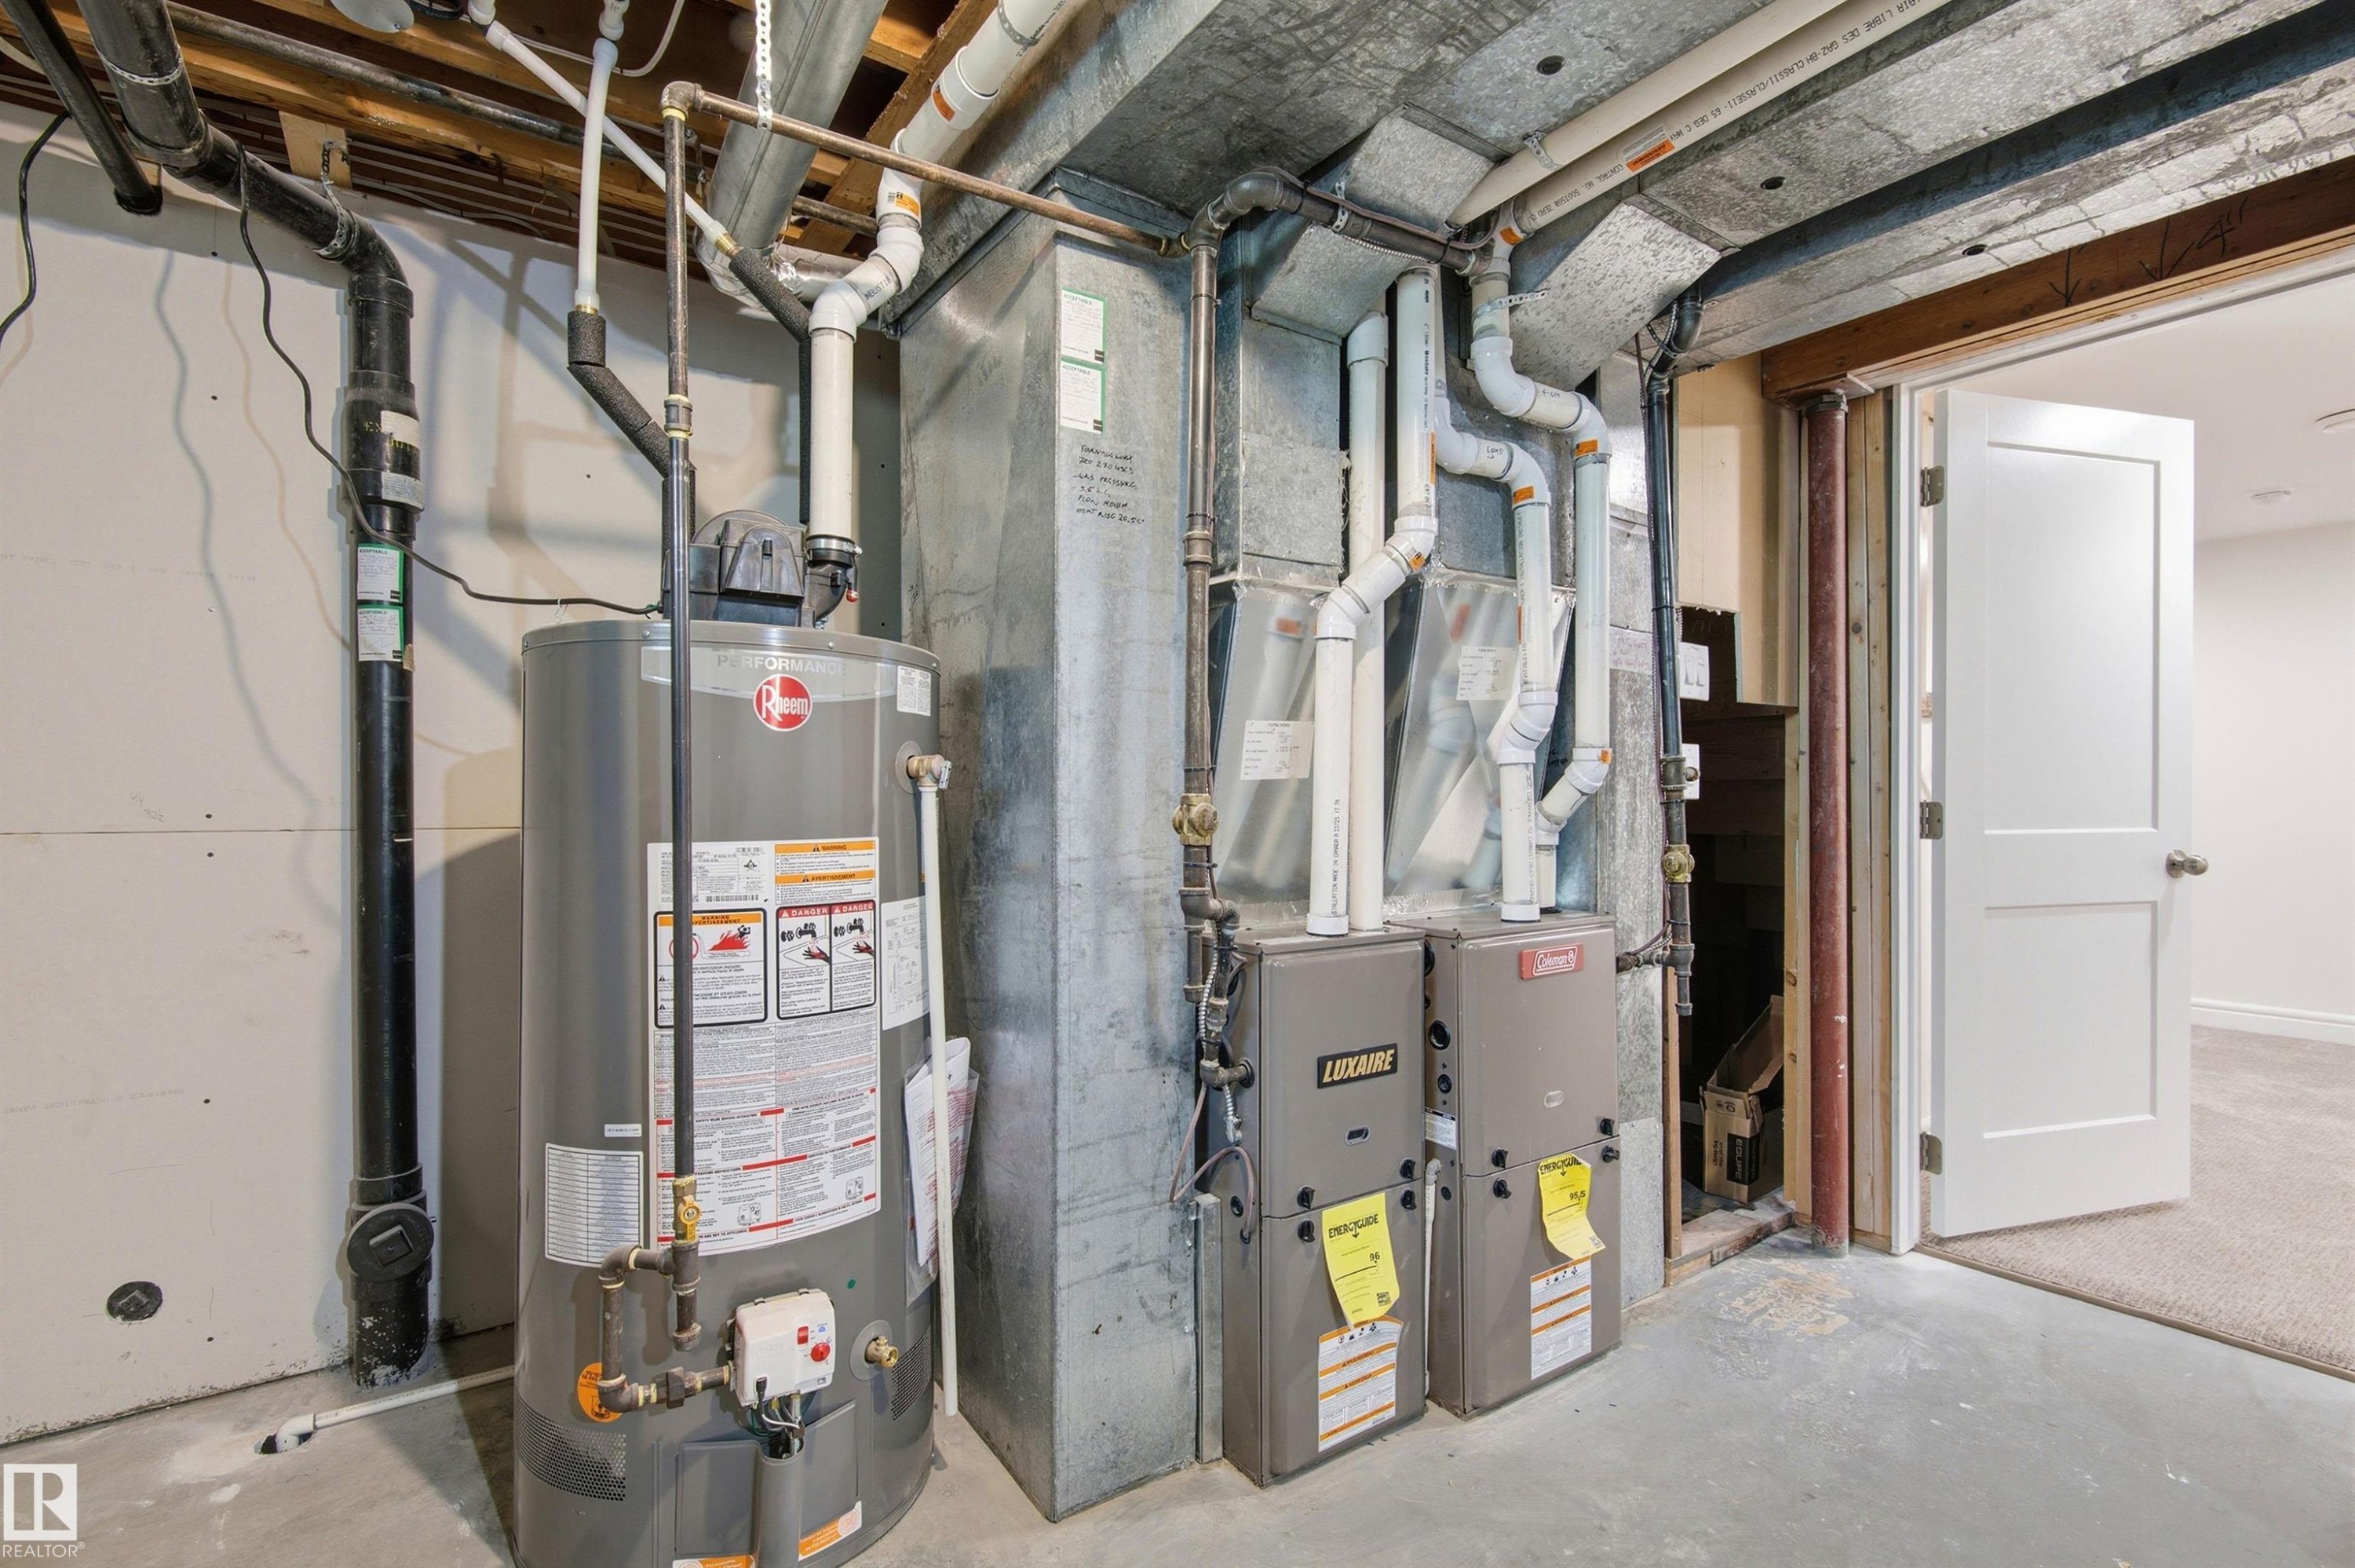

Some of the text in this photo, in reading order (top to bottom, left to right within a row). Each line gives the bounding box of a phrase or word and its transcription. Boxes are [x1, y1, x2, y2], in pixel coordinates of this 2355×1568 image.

[1863, 9, 1893, 32] LIBRE
[1842, 28, 1860, 44] DES
[1806, 40, 1839, 64] GAZ-BH
[1711, 108, 1722, 119] 65
[1685, 124, 1692, 133] C
[1693, 115, 1710, 128] DEG
[1595, 163, 1624, 182] CONTROL
[1582, 181, 1595, 190] NO.
[717, 655, 847, 675] PERFORMANCE
[761, 675, 809, 721] Rheem
[811, 873, 856, 881] AVERTISSEMENT
[792, 908, 828, 917] DANGER
[842, 903, 874, 913] DANGER
[1536, 953, 1568, 968] Coleman
[1323, 1049, 1395, 1083] LUXAIRE
[1328, 1214, 1379, 1238] ENERGYGUIDE
[1369, 1252, 1380, 1261] 96
